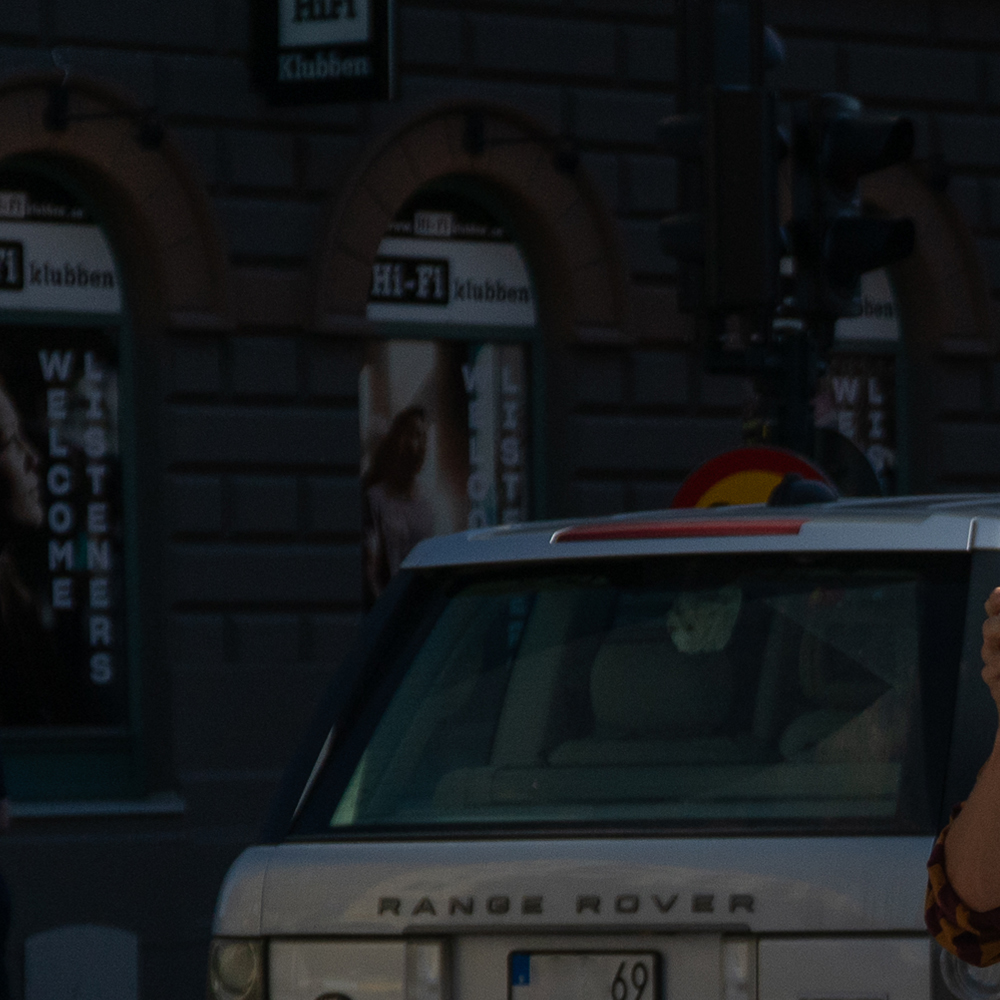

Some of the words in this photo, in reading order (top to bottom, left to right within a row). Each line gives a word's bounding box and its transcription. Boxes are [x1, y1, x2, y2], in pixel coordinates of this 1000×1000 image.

[30, 262, 114, 288] klubben
[372, 262, 444, 299] Hi-Fi
[453, 279, 529, 302] klubben
[38, 349, 74, 609] WELCOME
[84, 350, 113, 685] LISTENERS
[377, 895, 543, 916] RANGE
[576, 893, 755, 914] ROVER
